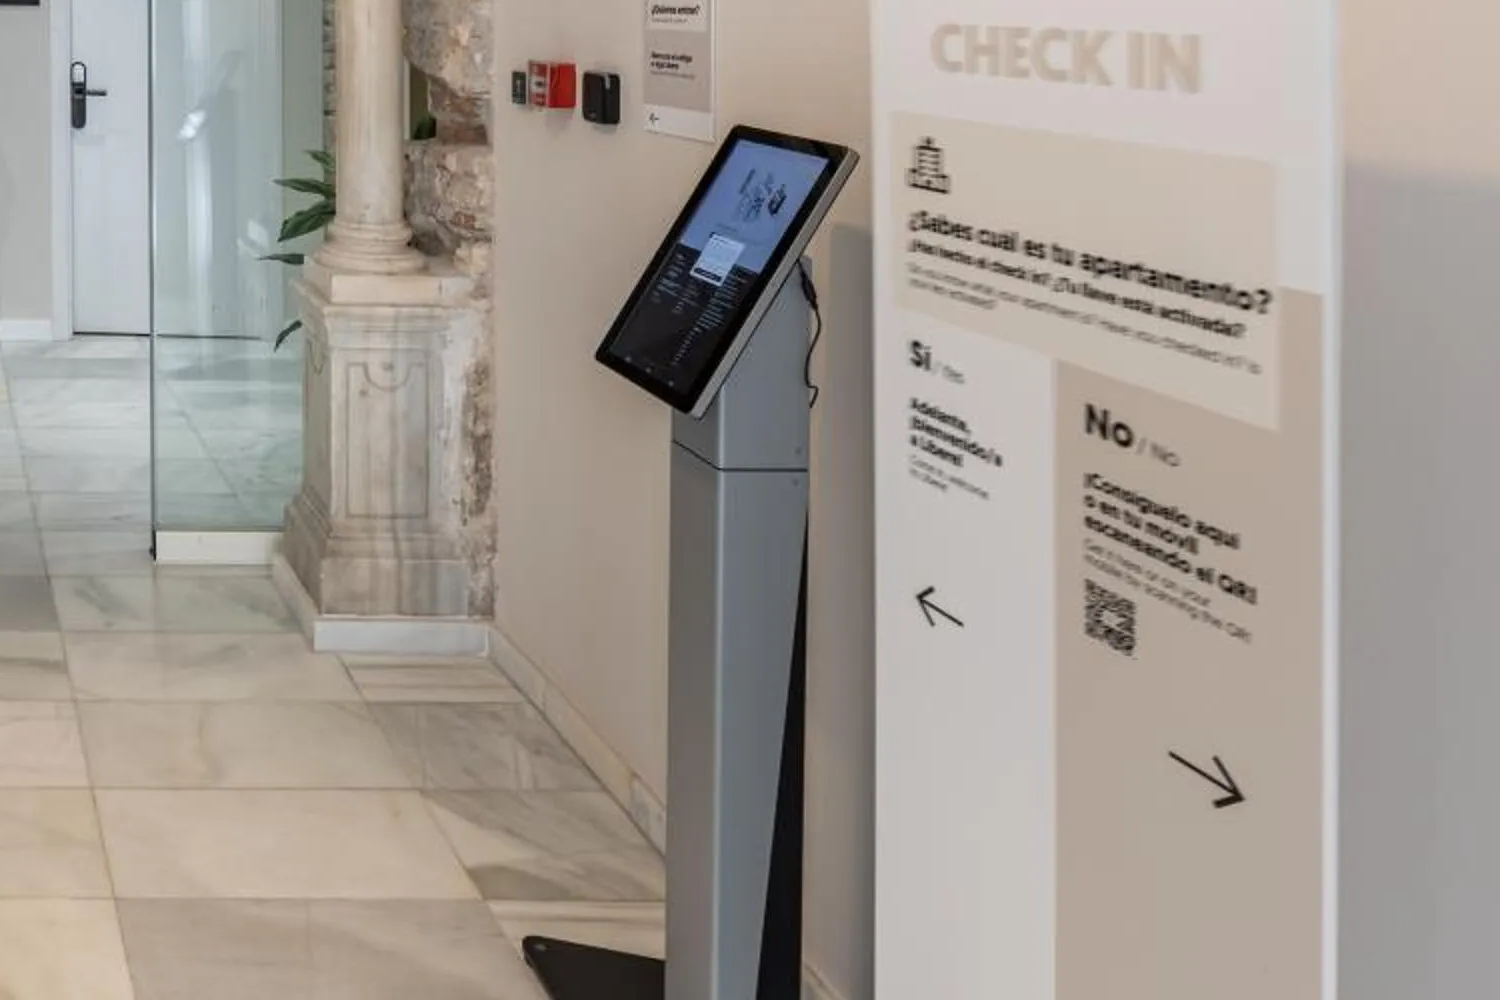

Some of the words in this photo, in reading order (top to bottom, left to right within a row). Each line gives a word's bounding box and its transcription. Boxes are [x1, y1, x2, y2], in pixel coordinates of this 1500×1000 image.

[930, 23, 1116, 87] CHECK
[1126, 30, 1204, 95] IN
[1023, 239, 1047, 260] es
[1051, 243, 1075, 267] tu
[1079, 252, 1272, 315] apartamento?
[1084, 403, 1134, 448] No
